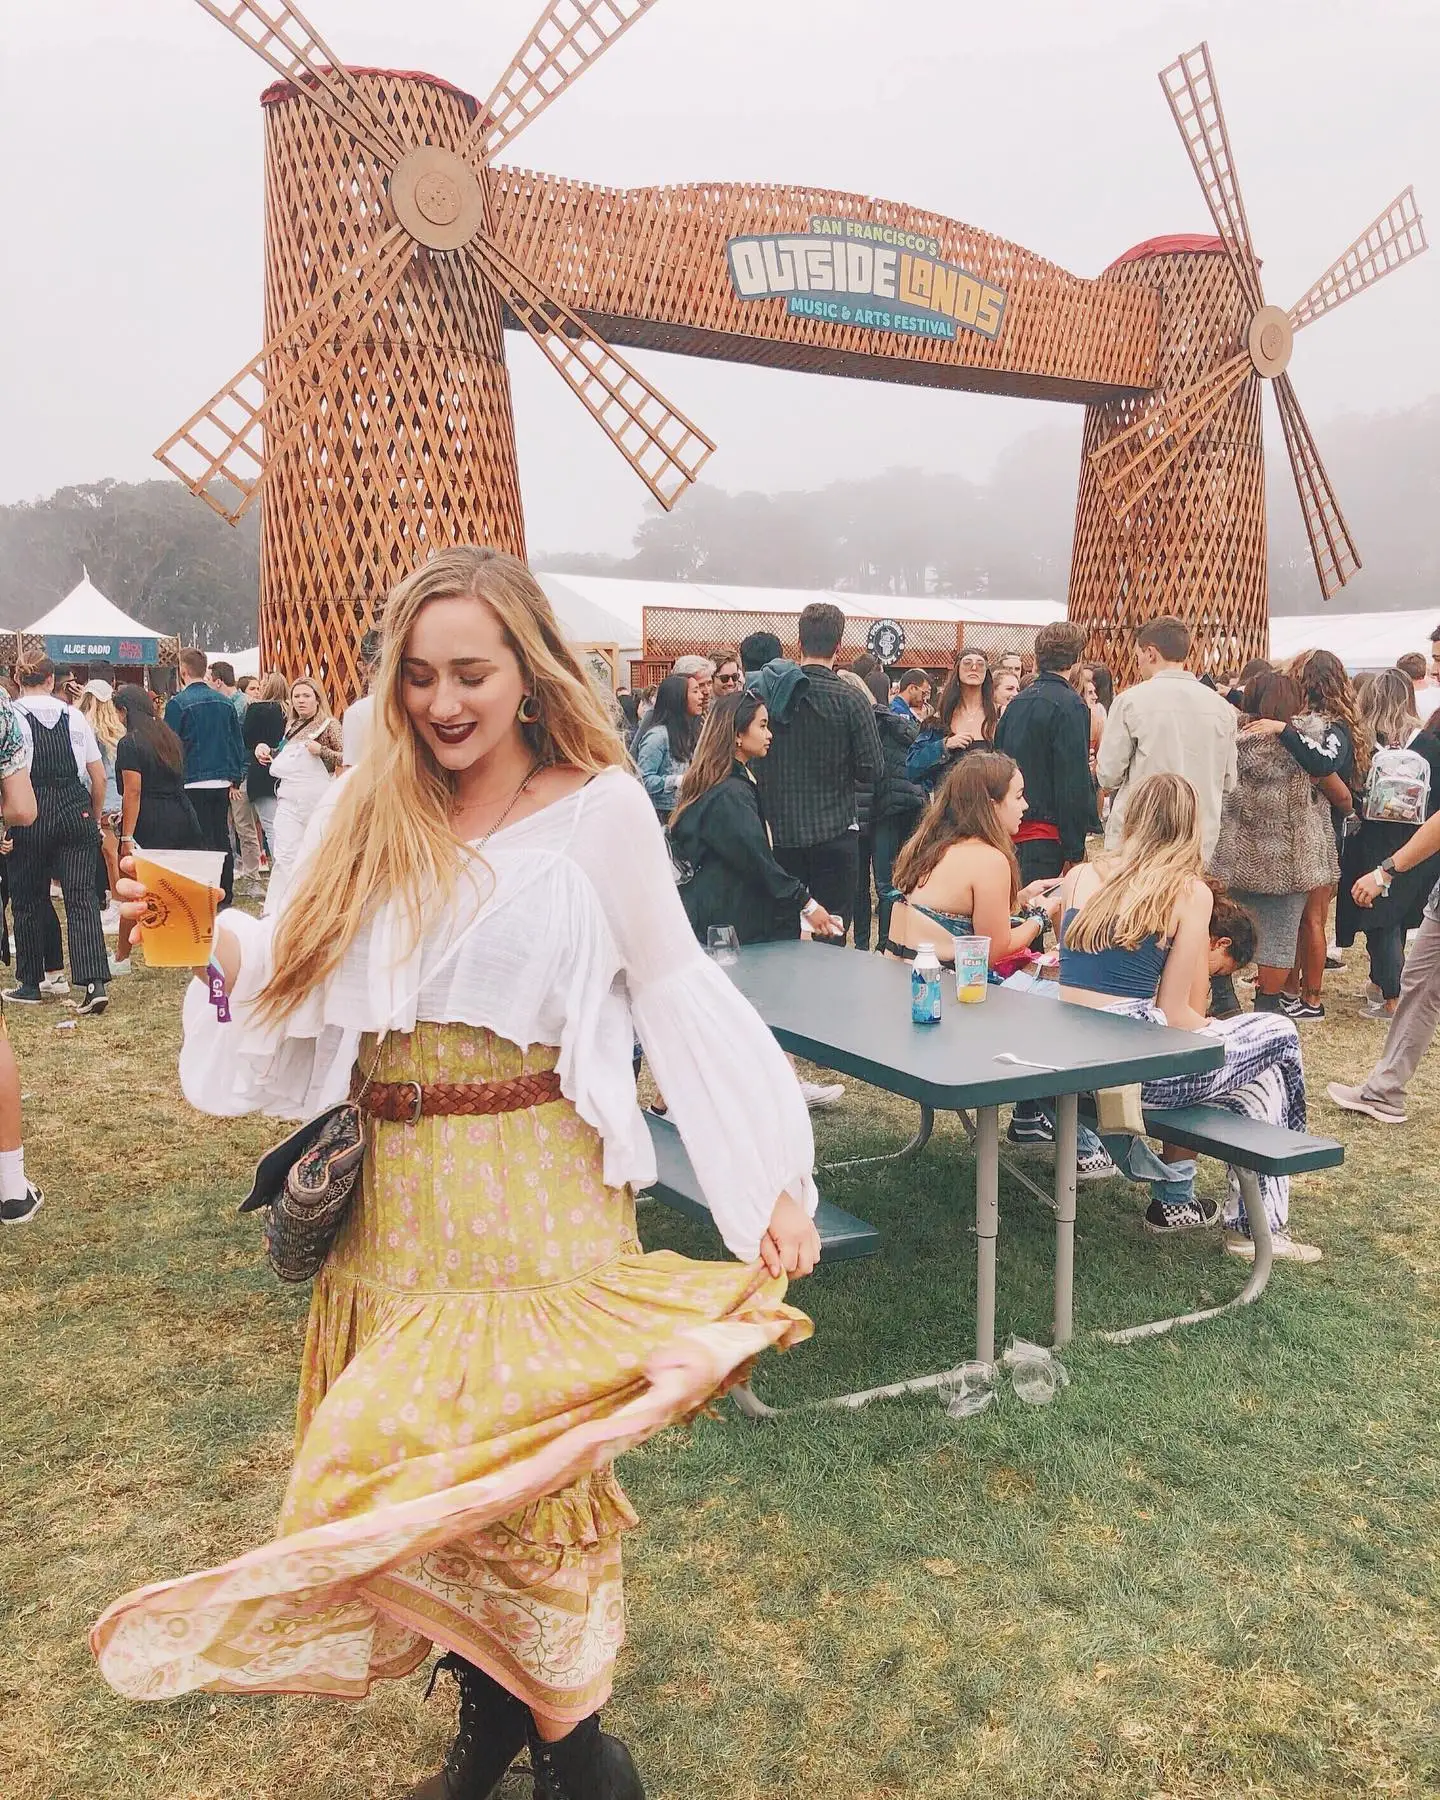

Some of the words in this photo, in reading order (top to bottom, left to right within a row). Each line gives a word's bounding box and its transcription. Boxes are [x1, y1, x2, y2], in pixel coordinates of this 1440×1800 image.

[812, 219, 842, 235] SAN
[846, 221, 938, 257] FRANCISCO'S
[731, 239, 897, 299] OUTSIDE
[900, 253, 1005, 335] LANDS
[790, 297, 838, 319] MUSIC
[841, 306, 851, 321] &
[854, 309, 891, 328] ARTS
[894, 314, 954, 337] FESTIVAL
[63, 644, 86, 654] ALICE
[87, 644, 111, 655] RADIO
[212, 979, 223, 998] GA
